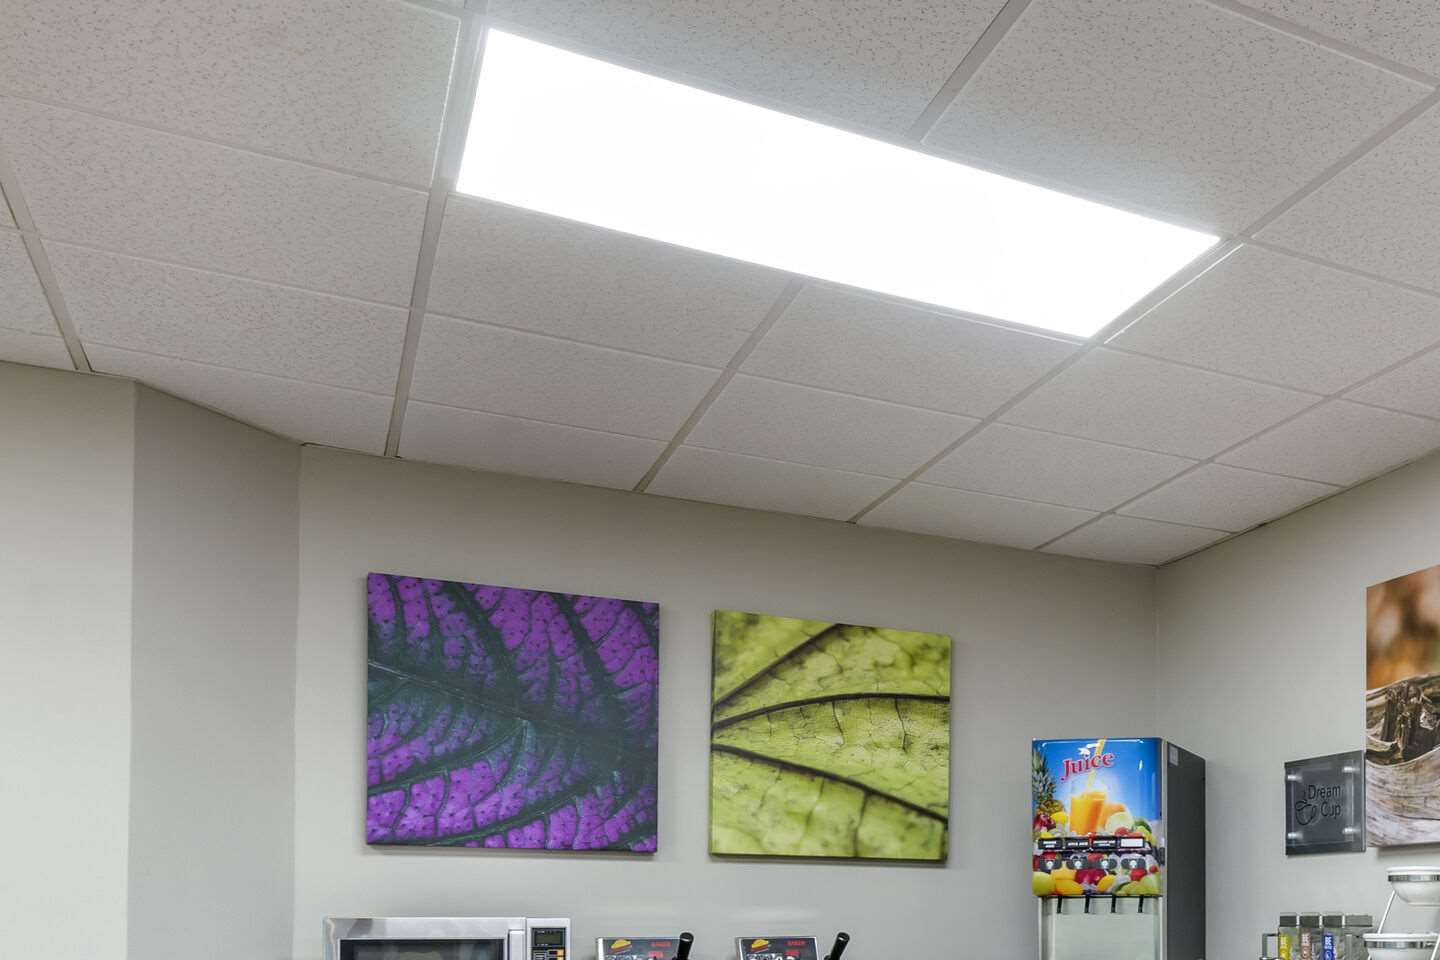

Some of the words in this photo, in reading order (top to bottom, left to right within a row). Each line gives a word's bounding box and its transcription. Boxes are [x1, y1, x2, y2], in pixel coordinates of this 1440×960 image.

[1060, 753, 1115, 781] Juice
[1308, 784, 1341, 800] Dream
[1320, 801, 1342, 819] Cup
